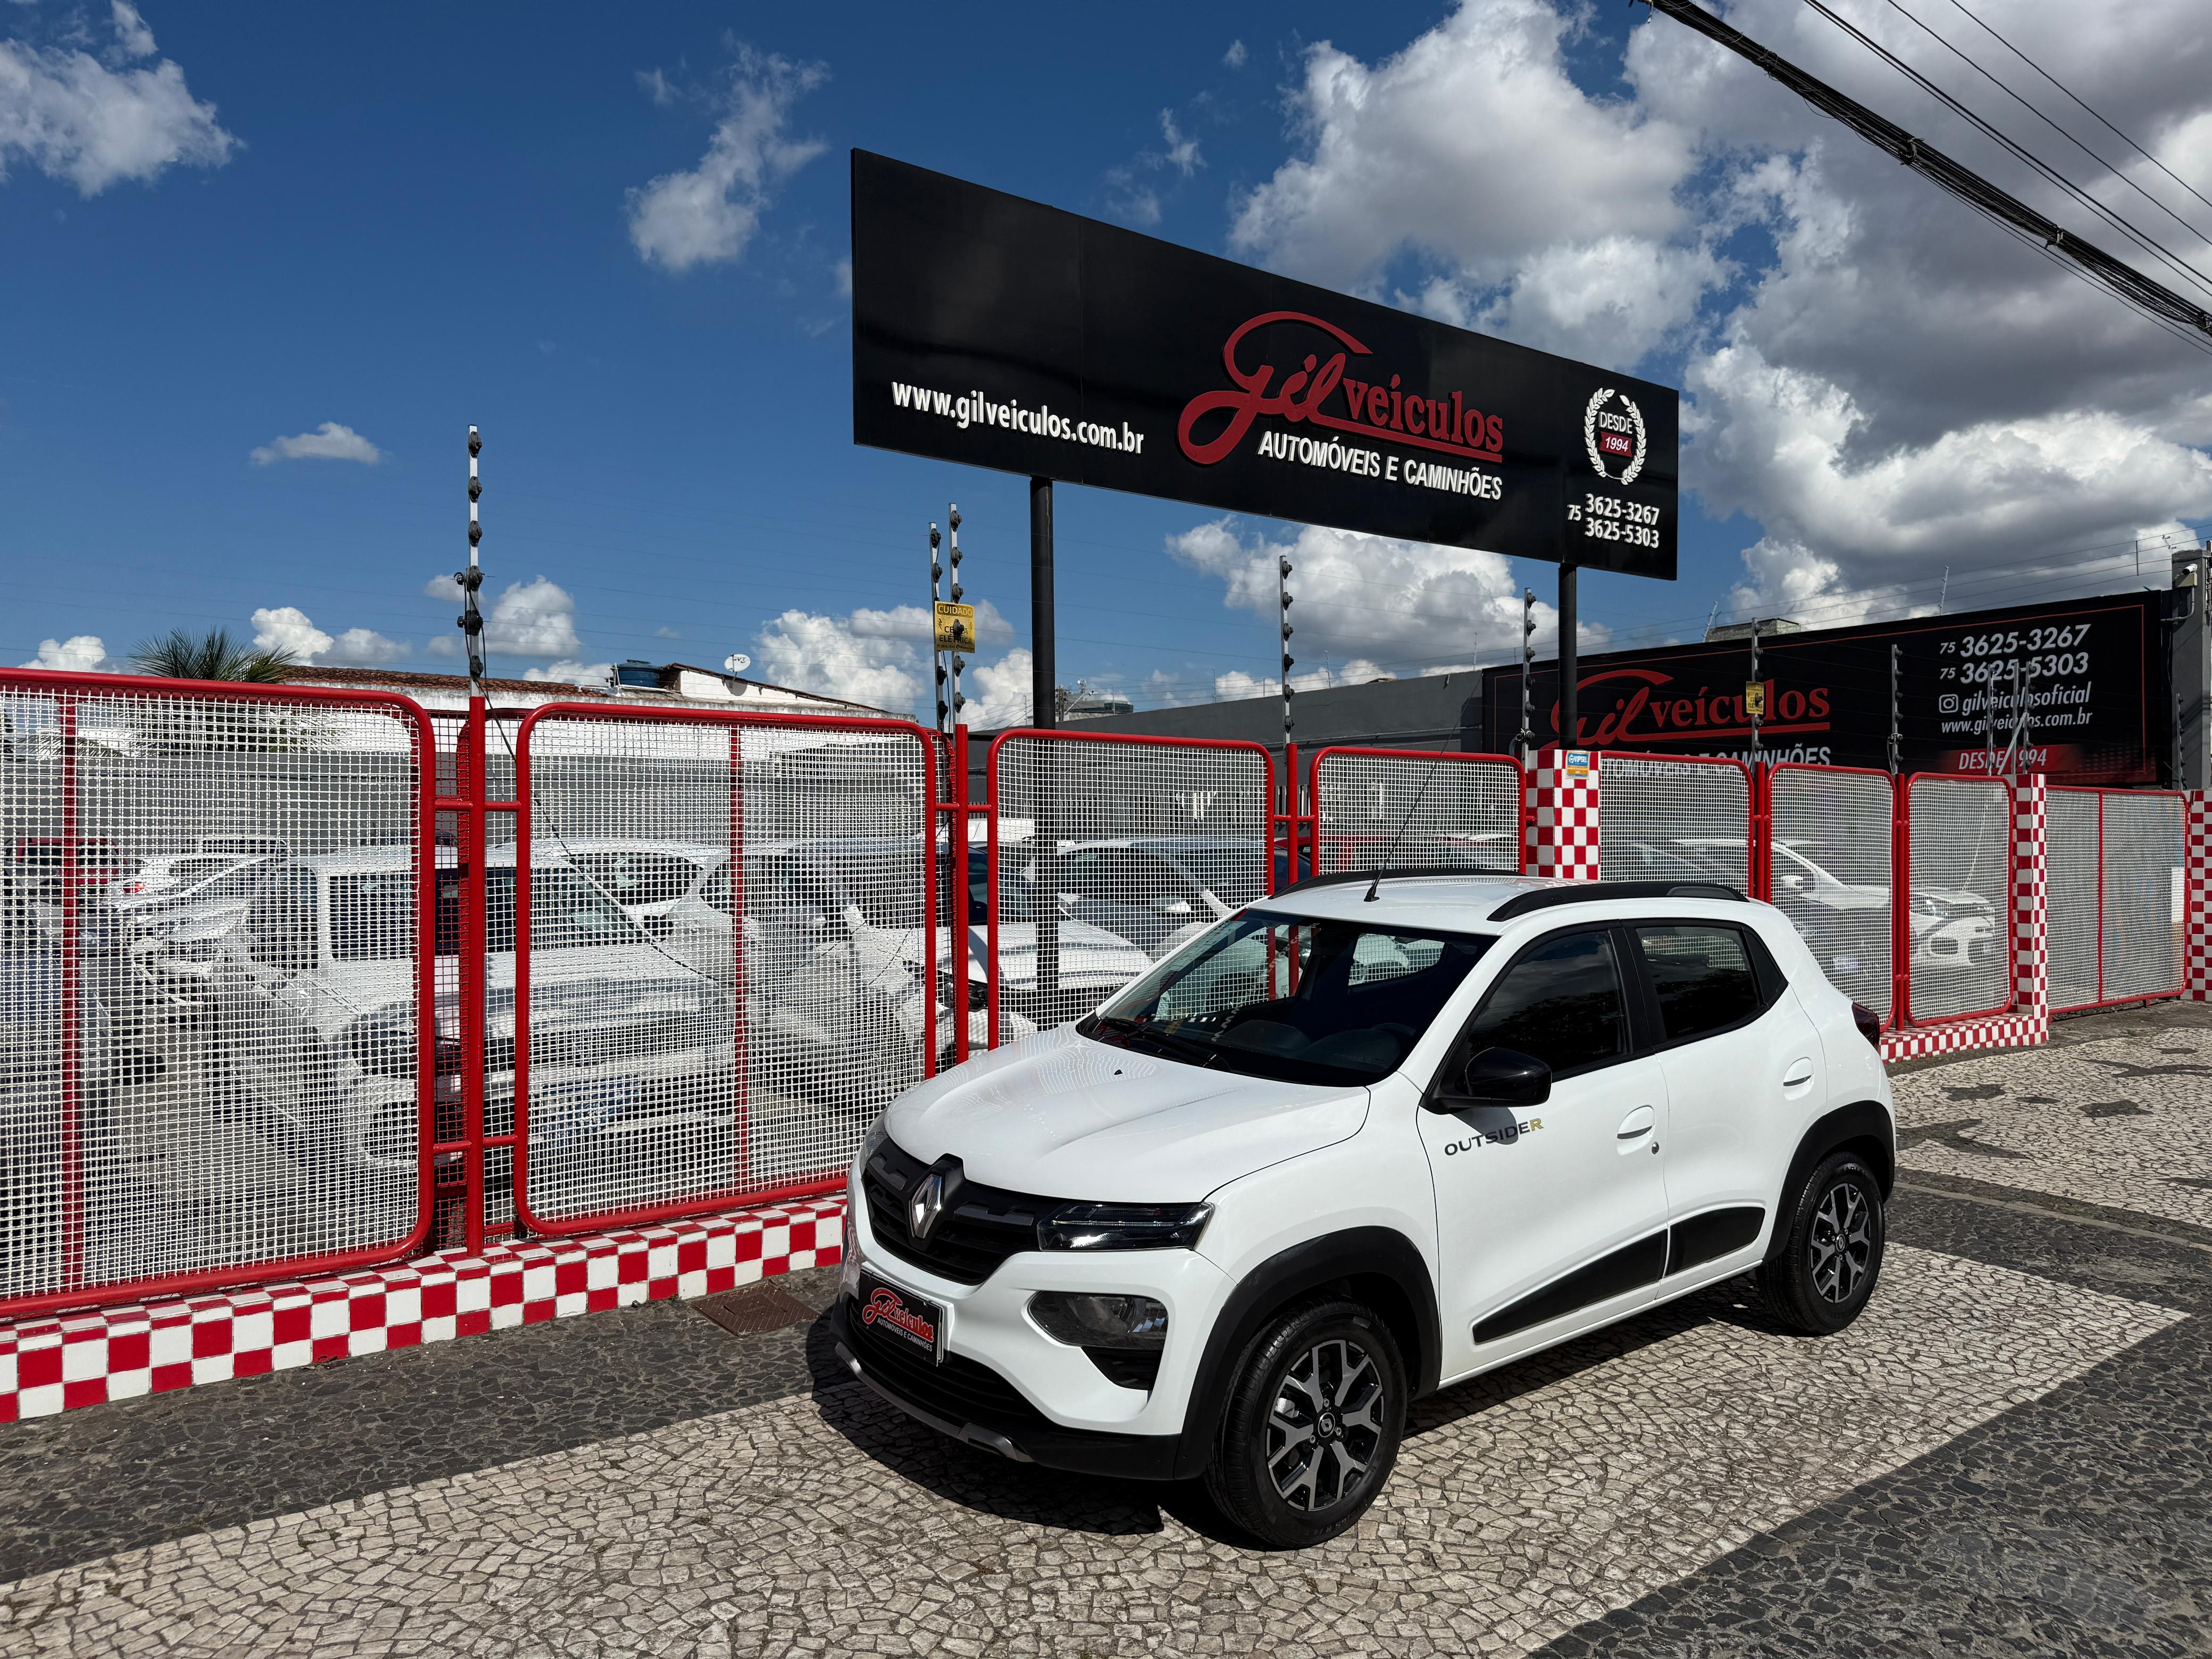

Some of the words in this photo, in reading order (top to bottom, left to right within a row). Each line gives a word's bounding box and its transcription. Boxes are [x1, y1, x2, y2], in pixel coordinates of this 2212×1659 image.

[891, 381, 1144, 454] www.gilveiculos.com.br
[1598, 411, 1633, 434] DESDE
[1605, 436, 1629, 453] 1994
[1257, 431, 1380, 477] AUTOMÓVEIS
[1385, 456, 1400, 481] E
[1404, 459, 1503, 501] CAMINHÕES
[1567, 504, 1581, 522] 75
[1585, 493, 1660, 526] 3625-3267
[1585, 517, 1659, 548] 3625-5303
[938, 605, 973, 616] CUIDADO
[944, 626, 969, 635] CEA
[1940, 642, 1956, 655] 75
[1960, 624, 2091, 657] 3625-3267
[1940, 667, 1956, 681] 75
[1960, 651, 2089, 684] 3625-5303
[1941, 706, 2093, 735] www.giveicos.com.br
[2010, 748, 2047, 767] 994
[1444, 1118, 1544, 1156] OUTSIDER
[877, 1317, 904, 1336] AUTOMÓVEIS
